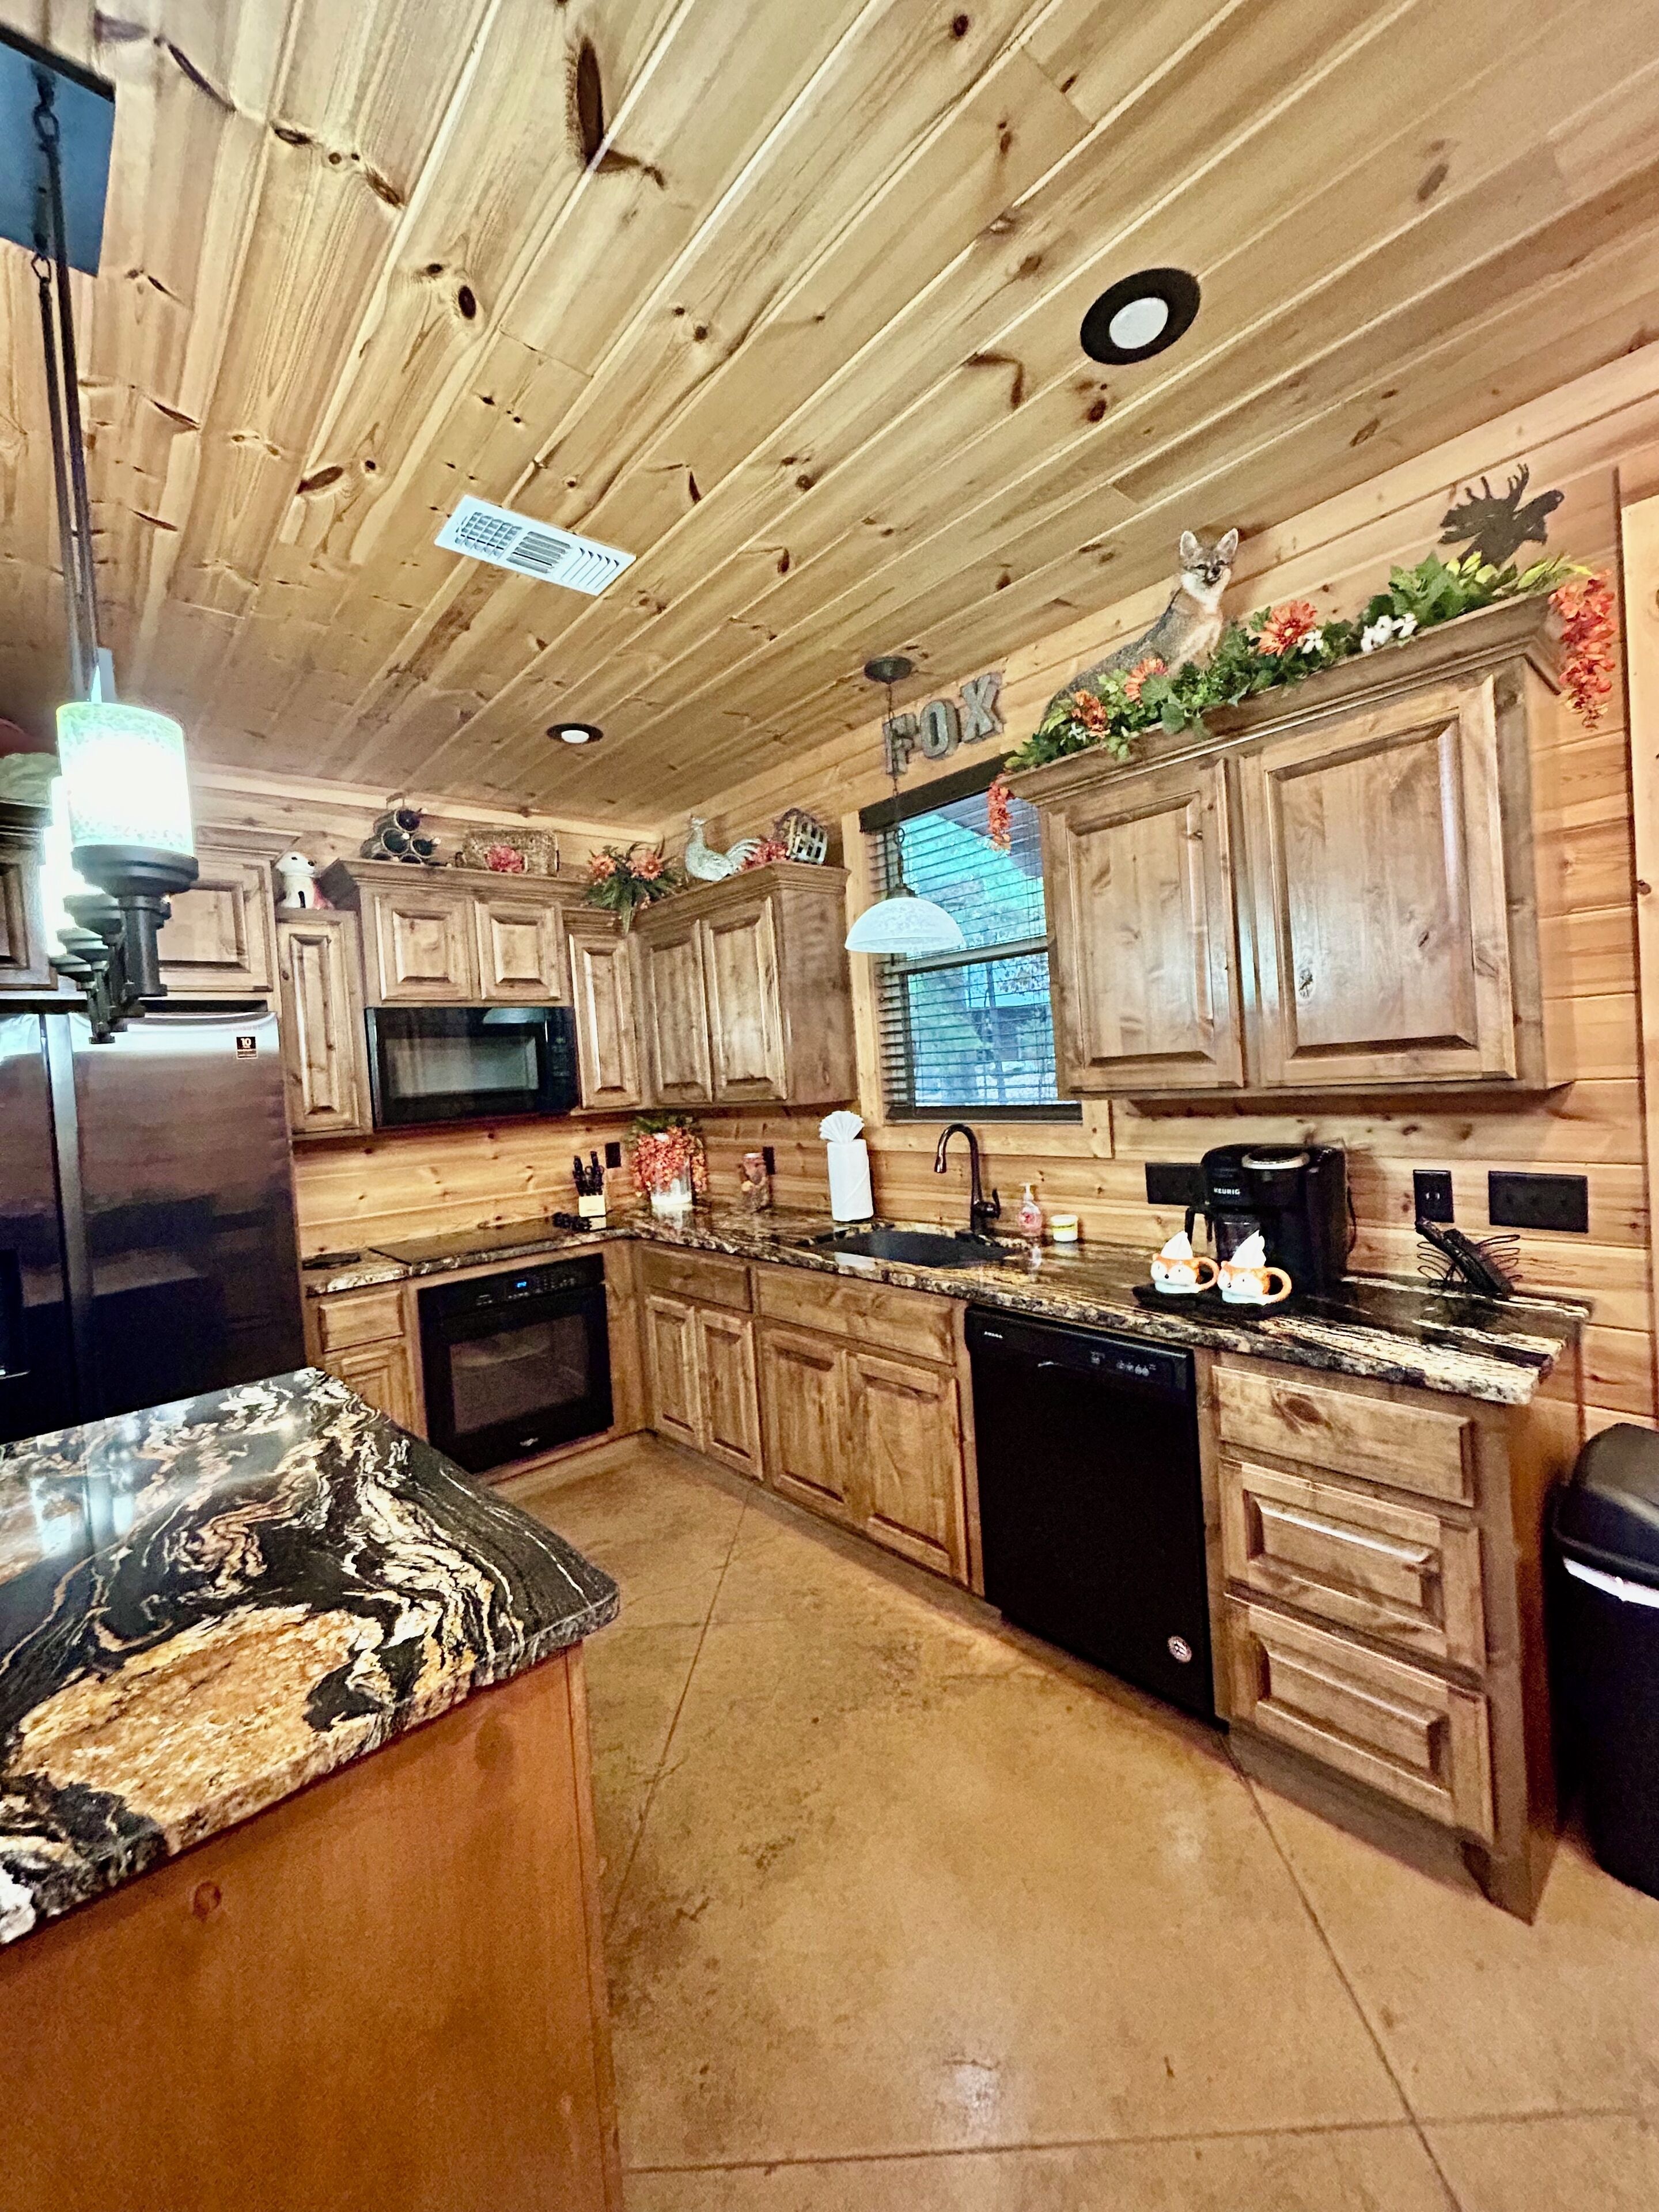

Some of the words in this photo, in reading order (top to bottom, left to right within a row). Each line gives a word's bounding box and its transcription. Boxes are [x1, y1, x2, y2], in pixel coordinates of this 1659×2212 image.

[883, 672, 1003, 776] FOX
[240, 1037, 252, 1046] 10
[1213, 1187, 1241, 1195] KEURIG
